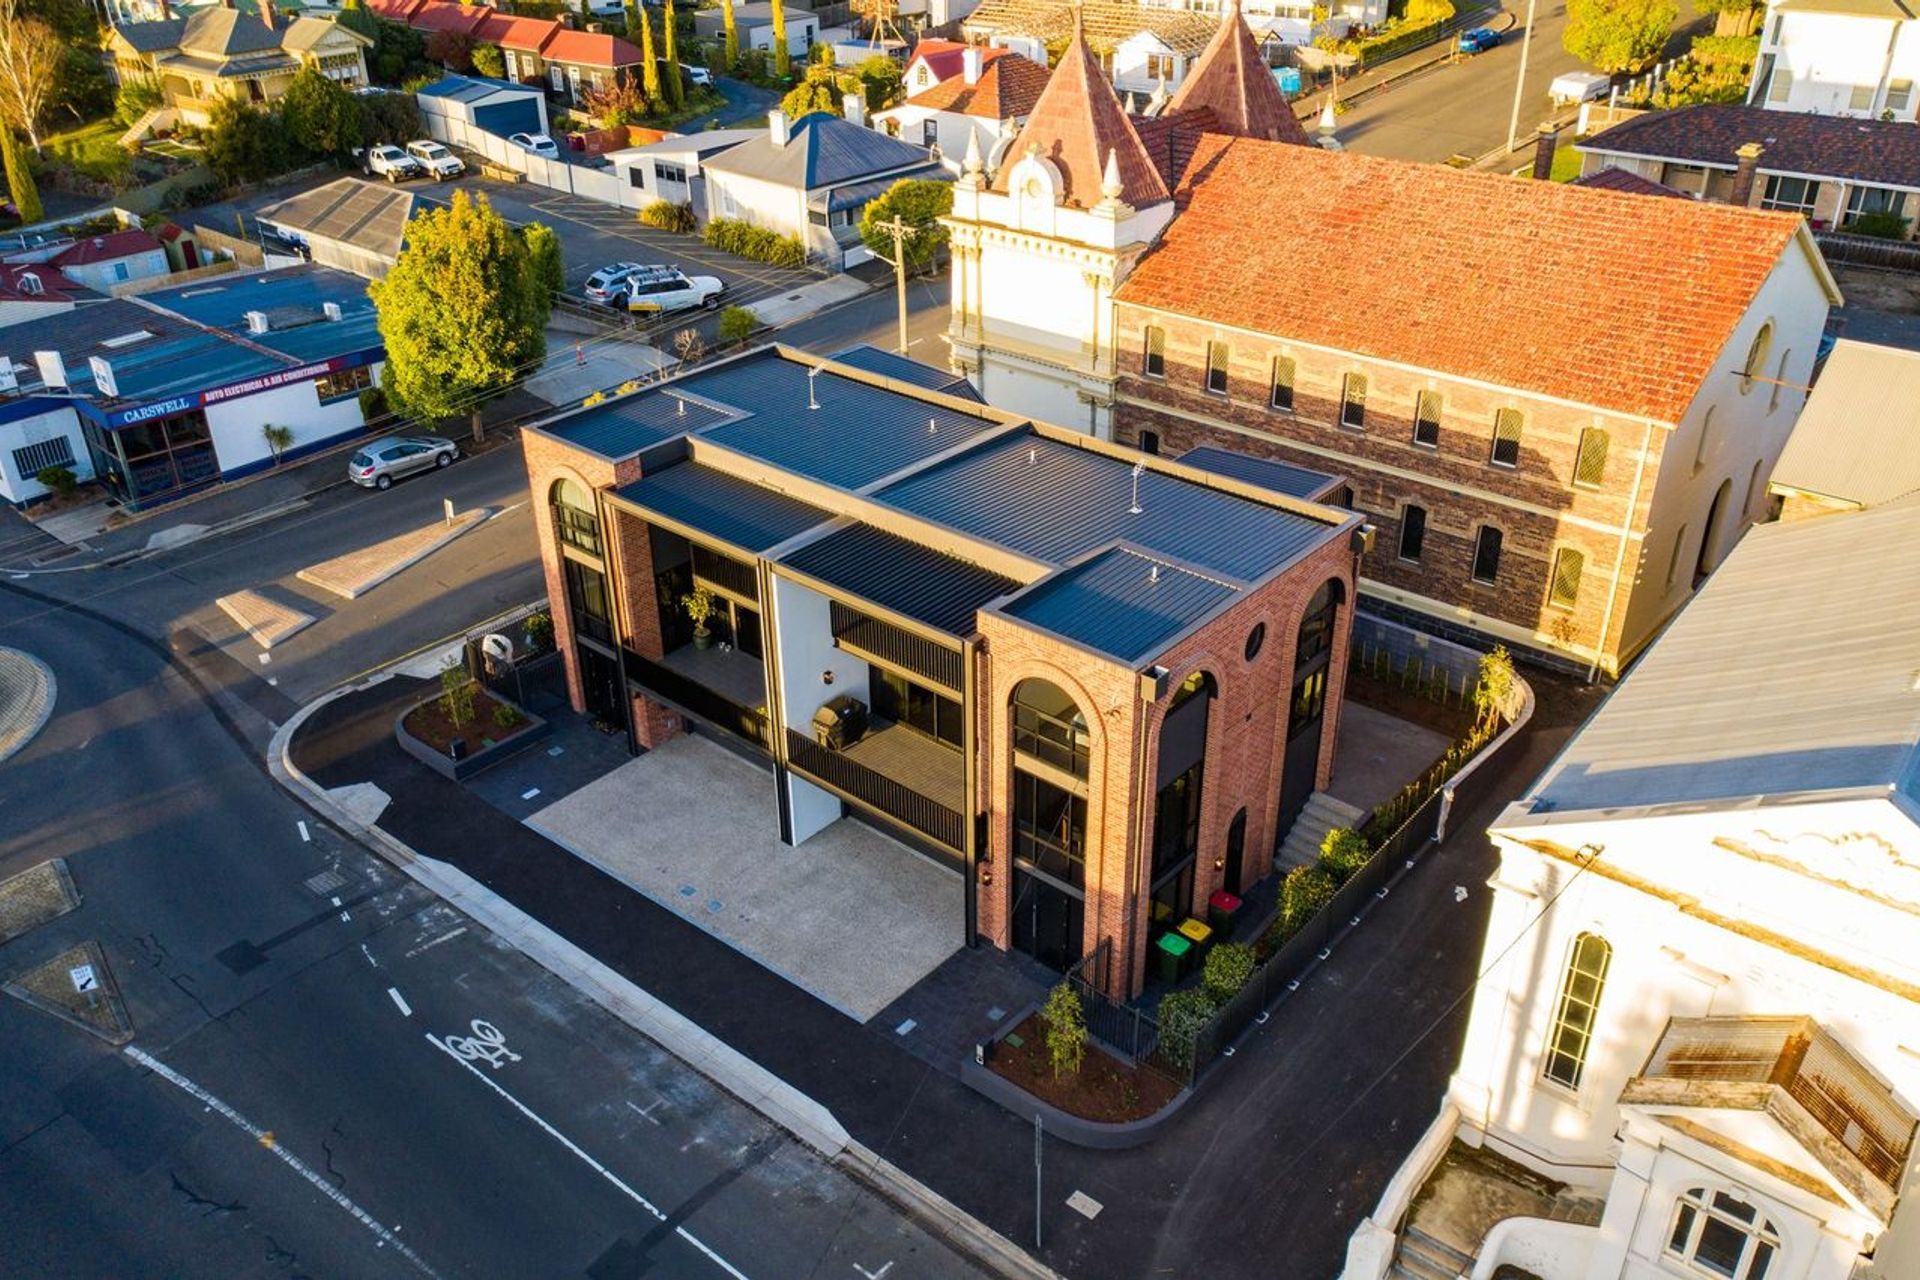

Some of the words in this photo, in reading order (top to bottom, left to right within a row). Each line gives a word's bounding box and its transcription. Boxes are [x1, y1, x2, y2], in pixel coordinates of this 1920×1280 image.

[205, 389, 224, 402] AUTO
[224, 380, 264, 397] ELECTRICAL
[270, 375, 283, 386] AIR
[282, 362, 330, 381] CONDITIONING
[123, 398, 190, 423] CARSWELL
